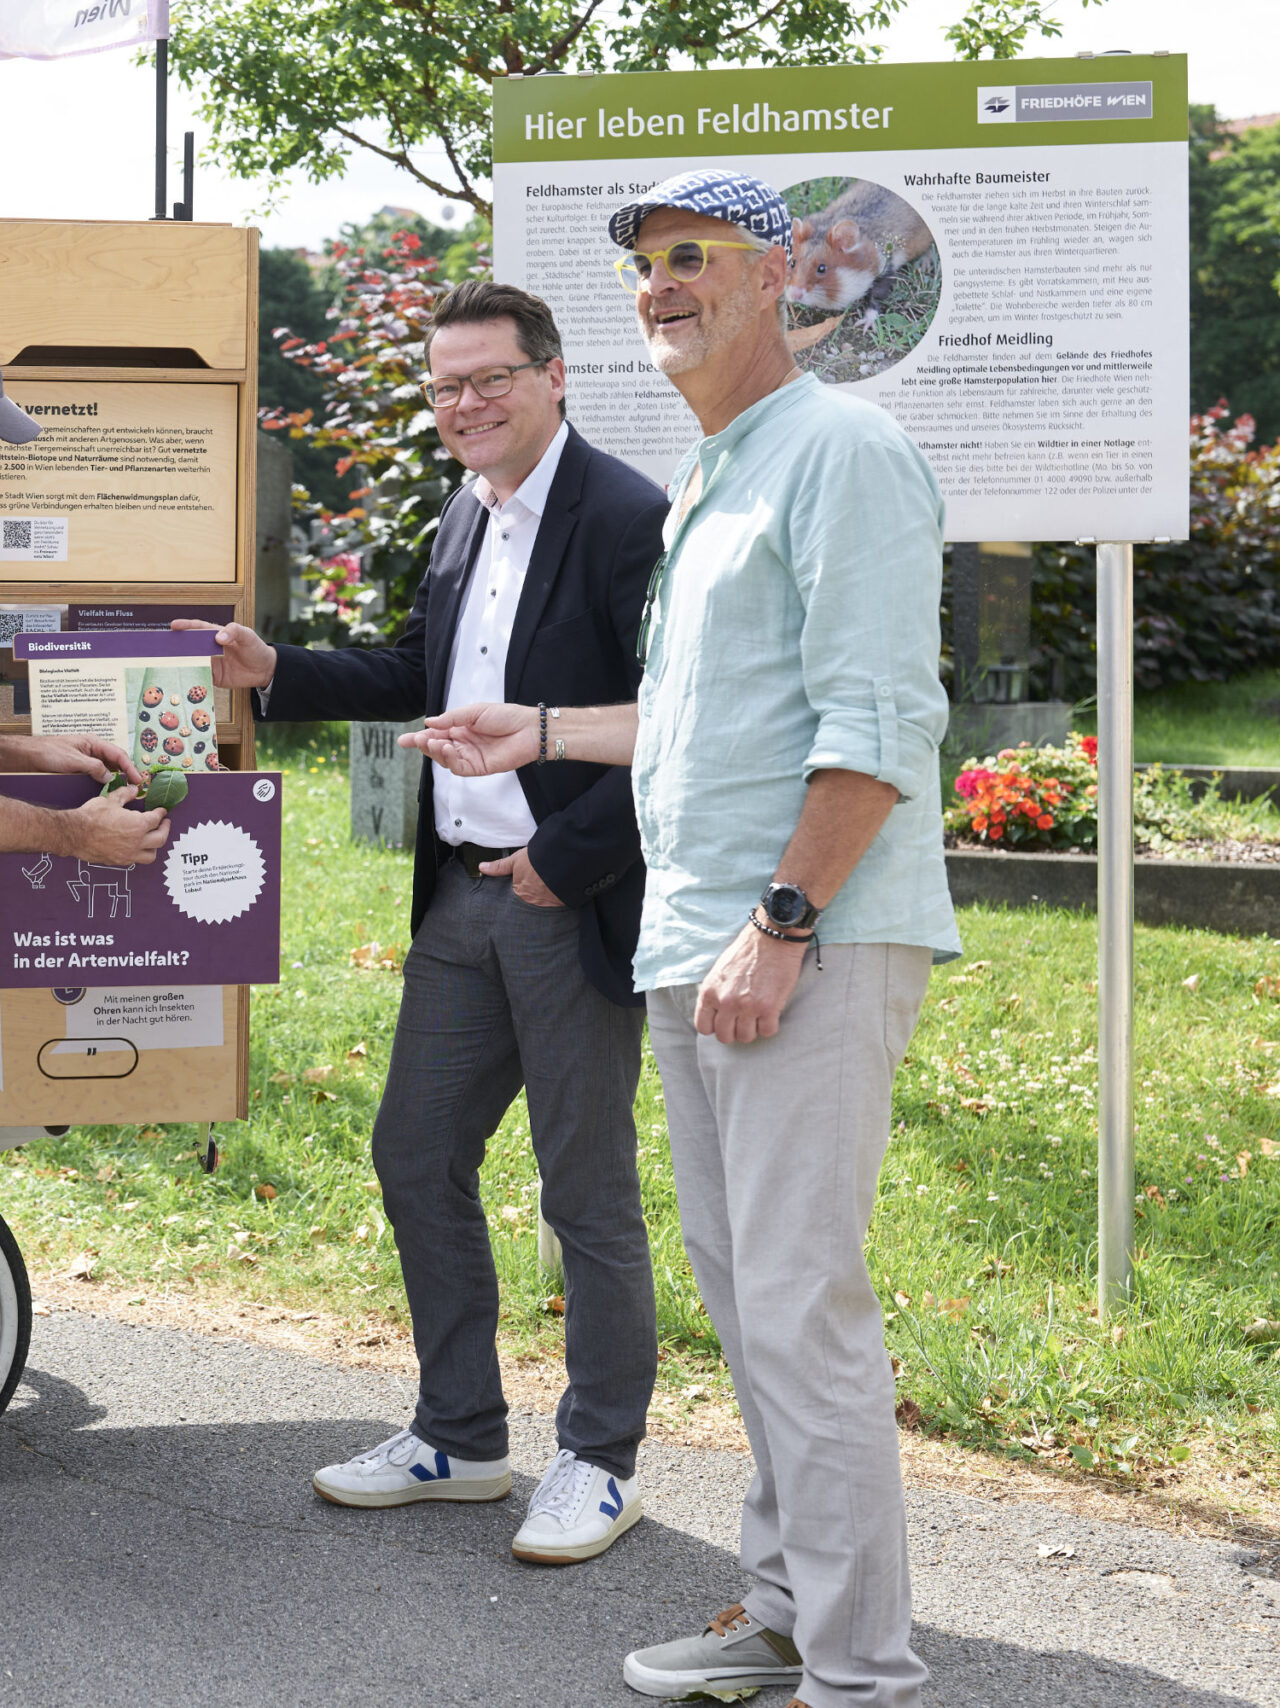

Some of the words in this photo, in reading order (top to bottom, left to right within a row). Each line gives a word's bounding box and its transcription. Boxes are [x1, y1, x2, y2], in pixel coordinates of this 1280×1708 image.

[1021, 94, 1101, 109] FRIEDHÖFE
[525, 111, 586, 140] Hier
[598, 107, 684, 137] leben
[697, 102, 893, 134] Feldhamster
[903, 172, 970, 185] Wahrhafte
[975, 170, 1050, 184] Baumeister
[526, 184, 603, 197] Feldhamster
[938, 332, 991, 346] Friedhof
[996, 332, 1052, 347] Meidling
[24, 402, 97, 416] vernetzt!
[74, 454, 118, 462] Naturräume
[28, 641, 91, 651] Biodiversität
[180, 852, 208, 865] Tipp
[13, 931, 51, 946] Was
[55, 932, 76, 946] ist
[80, 934, 114, 945] was
[14, 953, 29, 968] in
[34, 952, 64, 968] der
[68, 950, 189, 967] Artenvielfalt?
[103, 995, 118, 1003] Mit
[119, 994, 151, 1002] meinen
[152, 992, 184, 1003] großen
[93, 1006, 121, 1015] Ohren
[122, 1005, 143, 1013] kann
[145, 1004, 157, 1012] ich
[159, 1003, 194, 1011] Insekten
[96, 1017, 104, 1025] in
[106, 1016, 120, 1025] der
[122, 1015, 147, 1024] Nacht
[149, 1015, 163, 1025] gut
